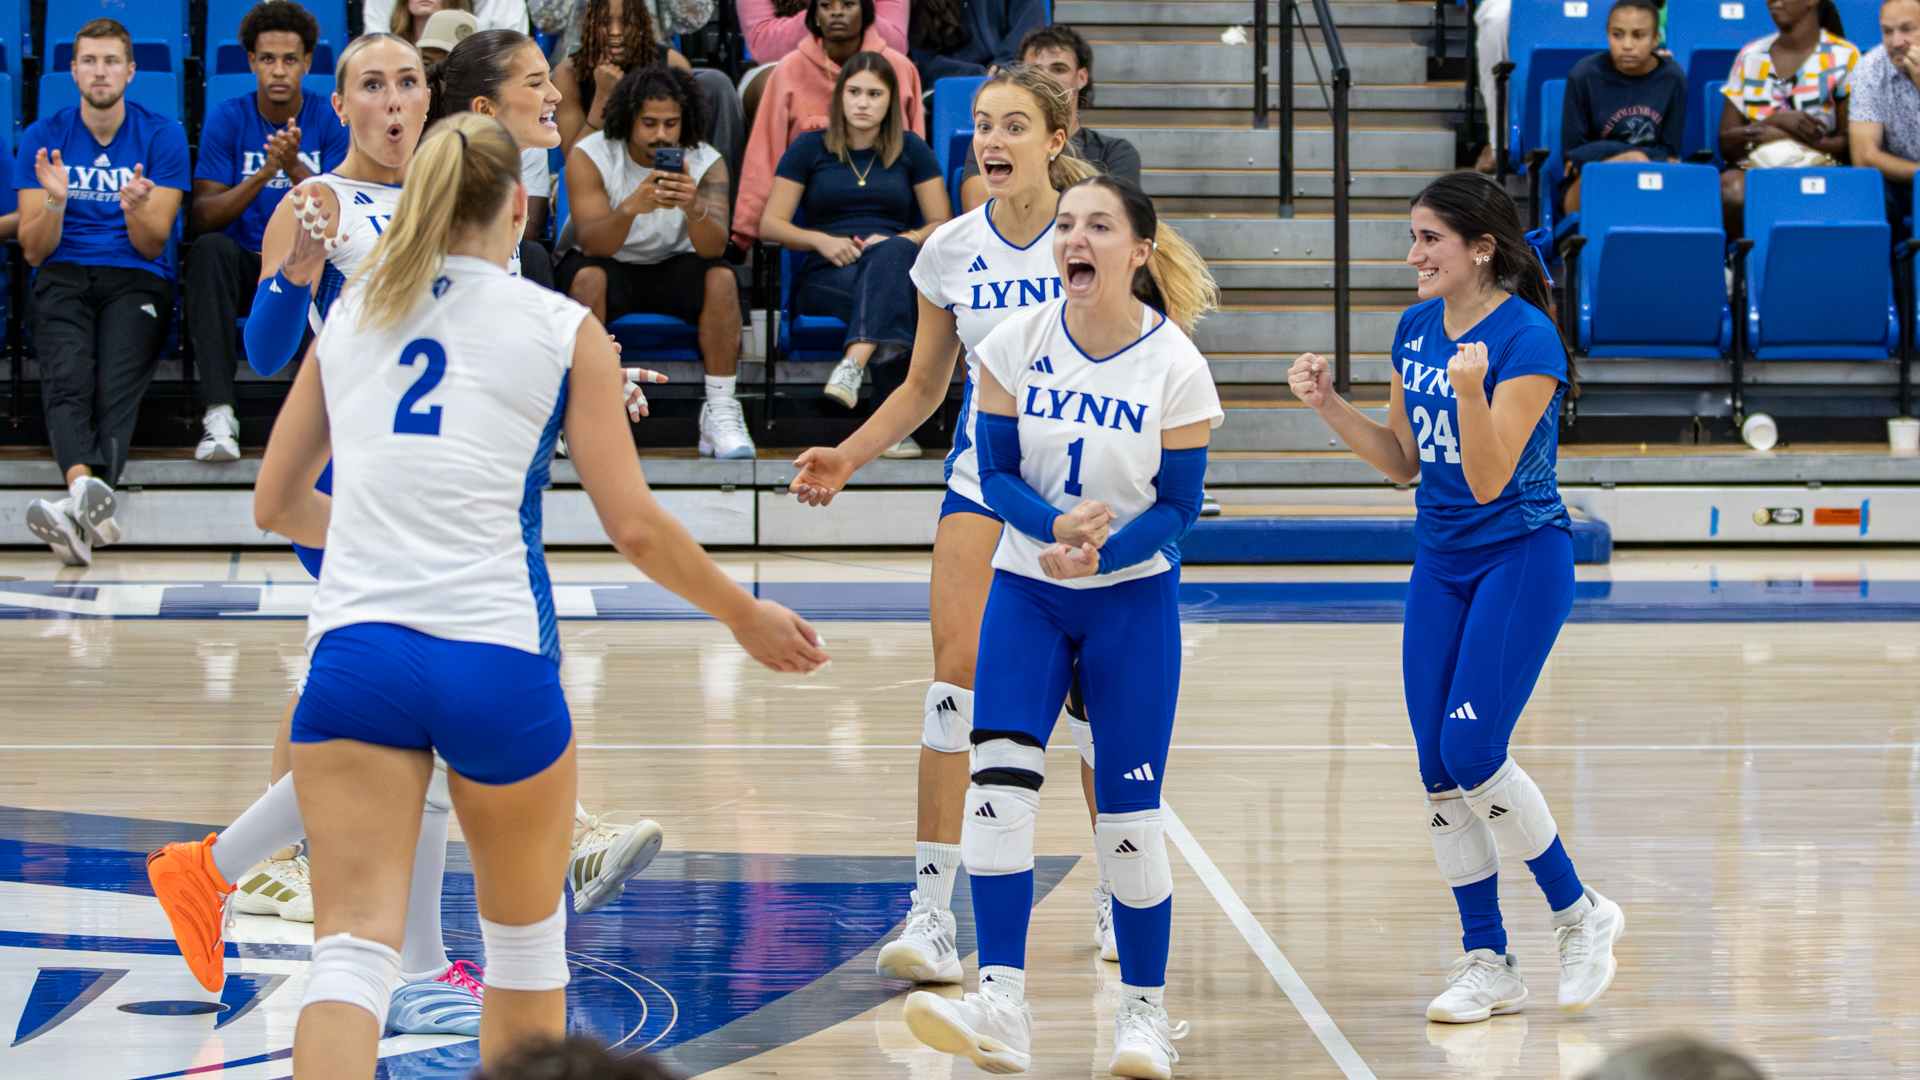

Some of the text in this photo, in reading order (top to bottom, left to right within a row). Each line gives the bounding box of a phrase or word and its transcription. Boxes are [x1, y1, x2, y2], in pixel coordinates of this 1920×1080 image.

[393, 338, 447, 436] 2
[1402, 357, 1457, 399] LYN
[1023, 384, 1149, 434] LYNN
[1413, 405, 1461, 464] 24
[1064, 437, 1084, 497] 1
